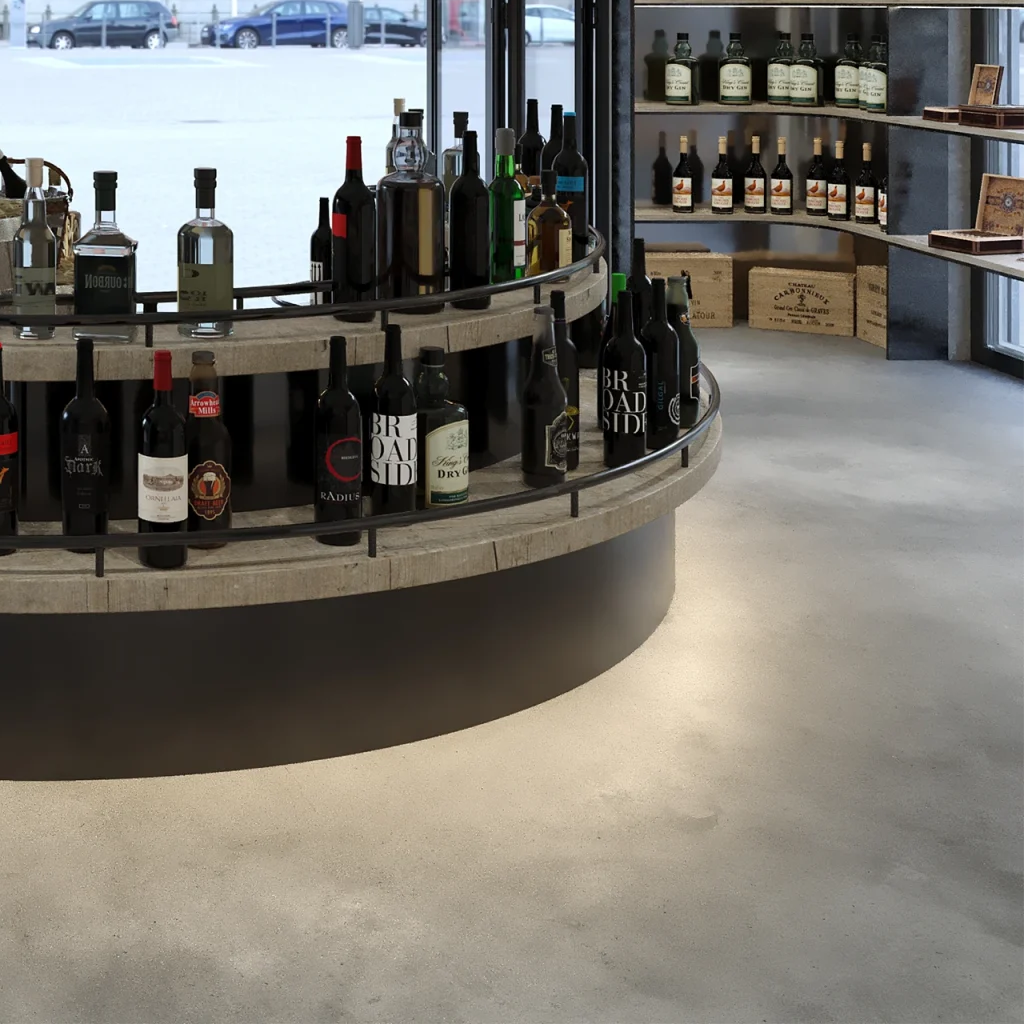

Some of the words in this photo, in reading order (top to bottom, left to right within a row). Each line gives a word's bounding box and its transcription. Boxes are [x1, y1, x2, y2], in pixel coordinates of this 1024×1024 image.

[80, 444, 90, 454] A
[437, 469, 460, 479] DRY
[320, 490, 360, 502] RADIUS
